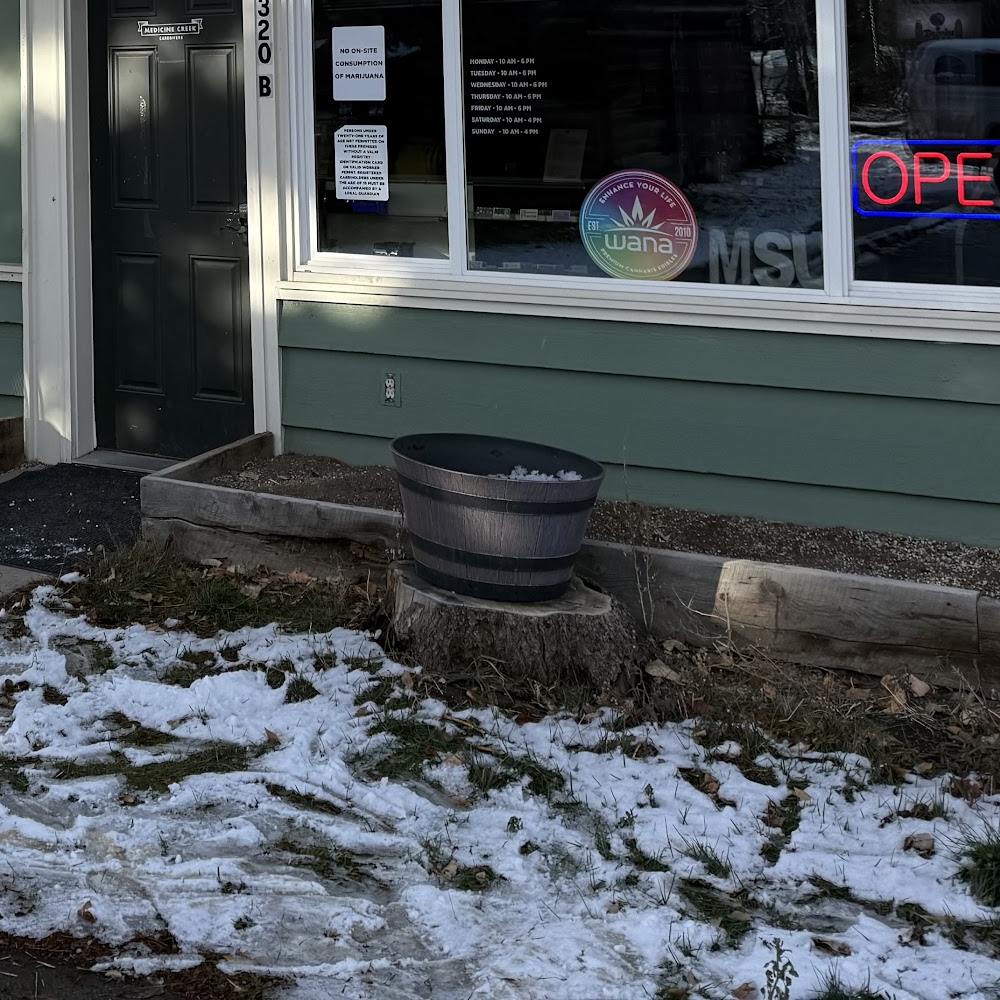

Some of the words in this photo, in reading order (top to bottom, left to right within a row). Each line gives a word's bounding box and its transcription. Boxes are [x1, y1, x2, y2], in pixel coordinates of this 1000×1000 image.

[259, 76, 272, 97] B
[861, 151, 995, 206] OPE
[599, 182, 634, 204] ENHANCE
[637, 182, 660, 194] YOUR
[660, 190, 677, 209] LIFE
[674, 226, 691, 237] 2010
[604, 234, 673, 254] wana
[600, 248, 624, 268] PREMIUM
[625, 266, 657, 274] CANNABIS
[658, 254, 678, 271] EDIBLES
